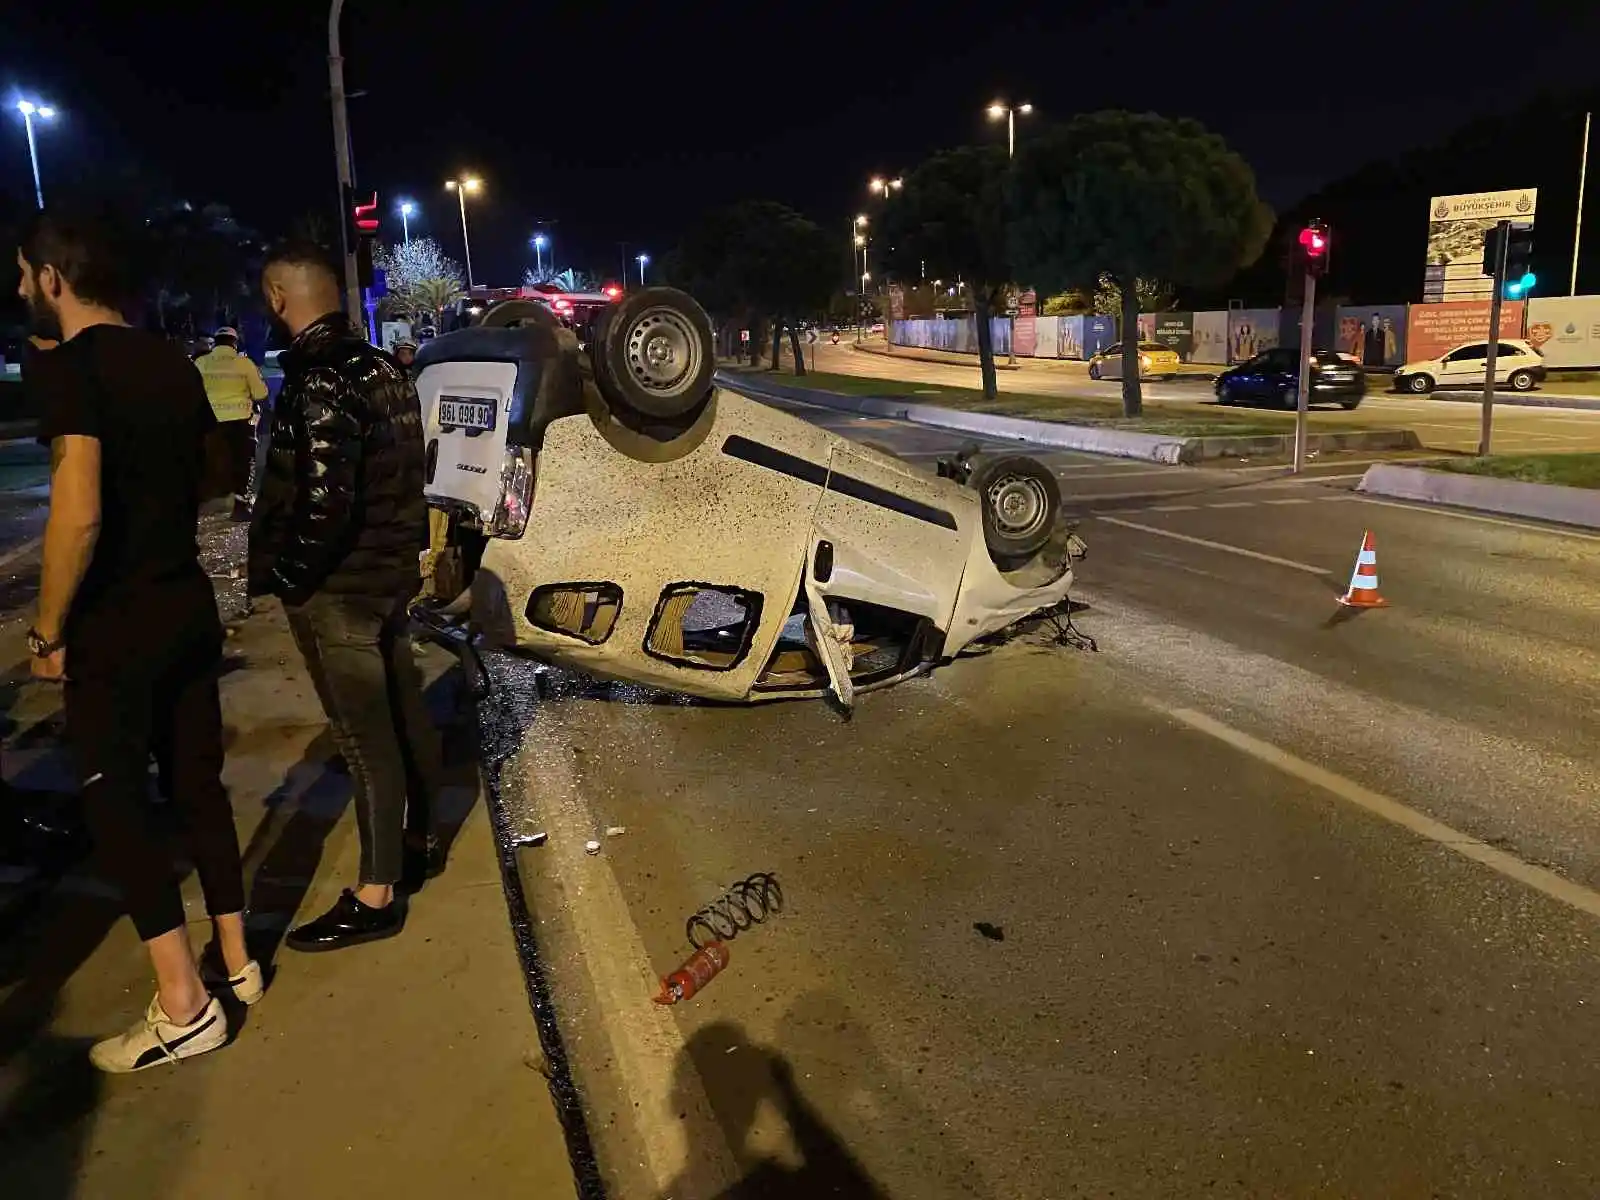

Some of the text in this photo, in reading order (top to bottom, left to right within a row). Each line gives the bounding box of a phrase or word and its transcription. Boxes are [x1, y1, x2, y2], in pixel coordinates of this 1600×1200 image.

[442, 404, 455, 421] 196
[459, 405, 474, 424] BGD
[478, 407, 488, 425] 06
